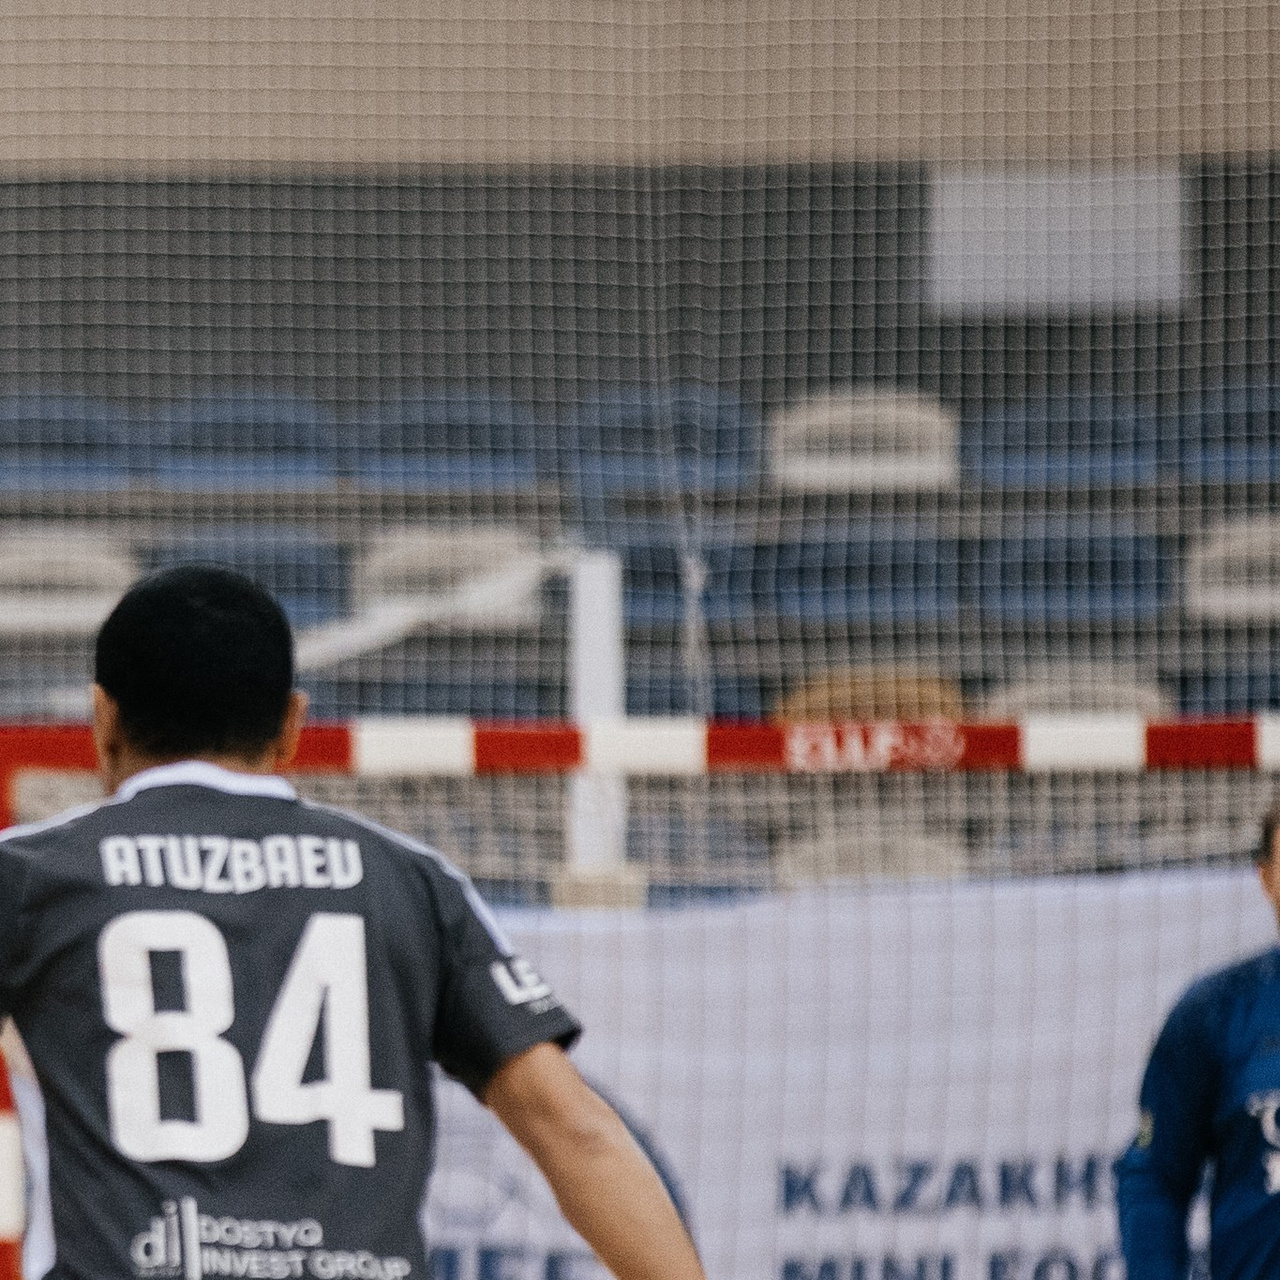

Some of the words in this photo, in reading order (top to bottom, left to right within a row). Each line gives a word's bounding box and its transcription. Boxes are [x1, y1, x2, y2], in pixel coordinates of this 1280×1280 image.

[97, 909, 404, 1168] 84
[776, 1155, 1120, 1214] KAZAKH
[200, 1248, 304, 1279] INVEST
